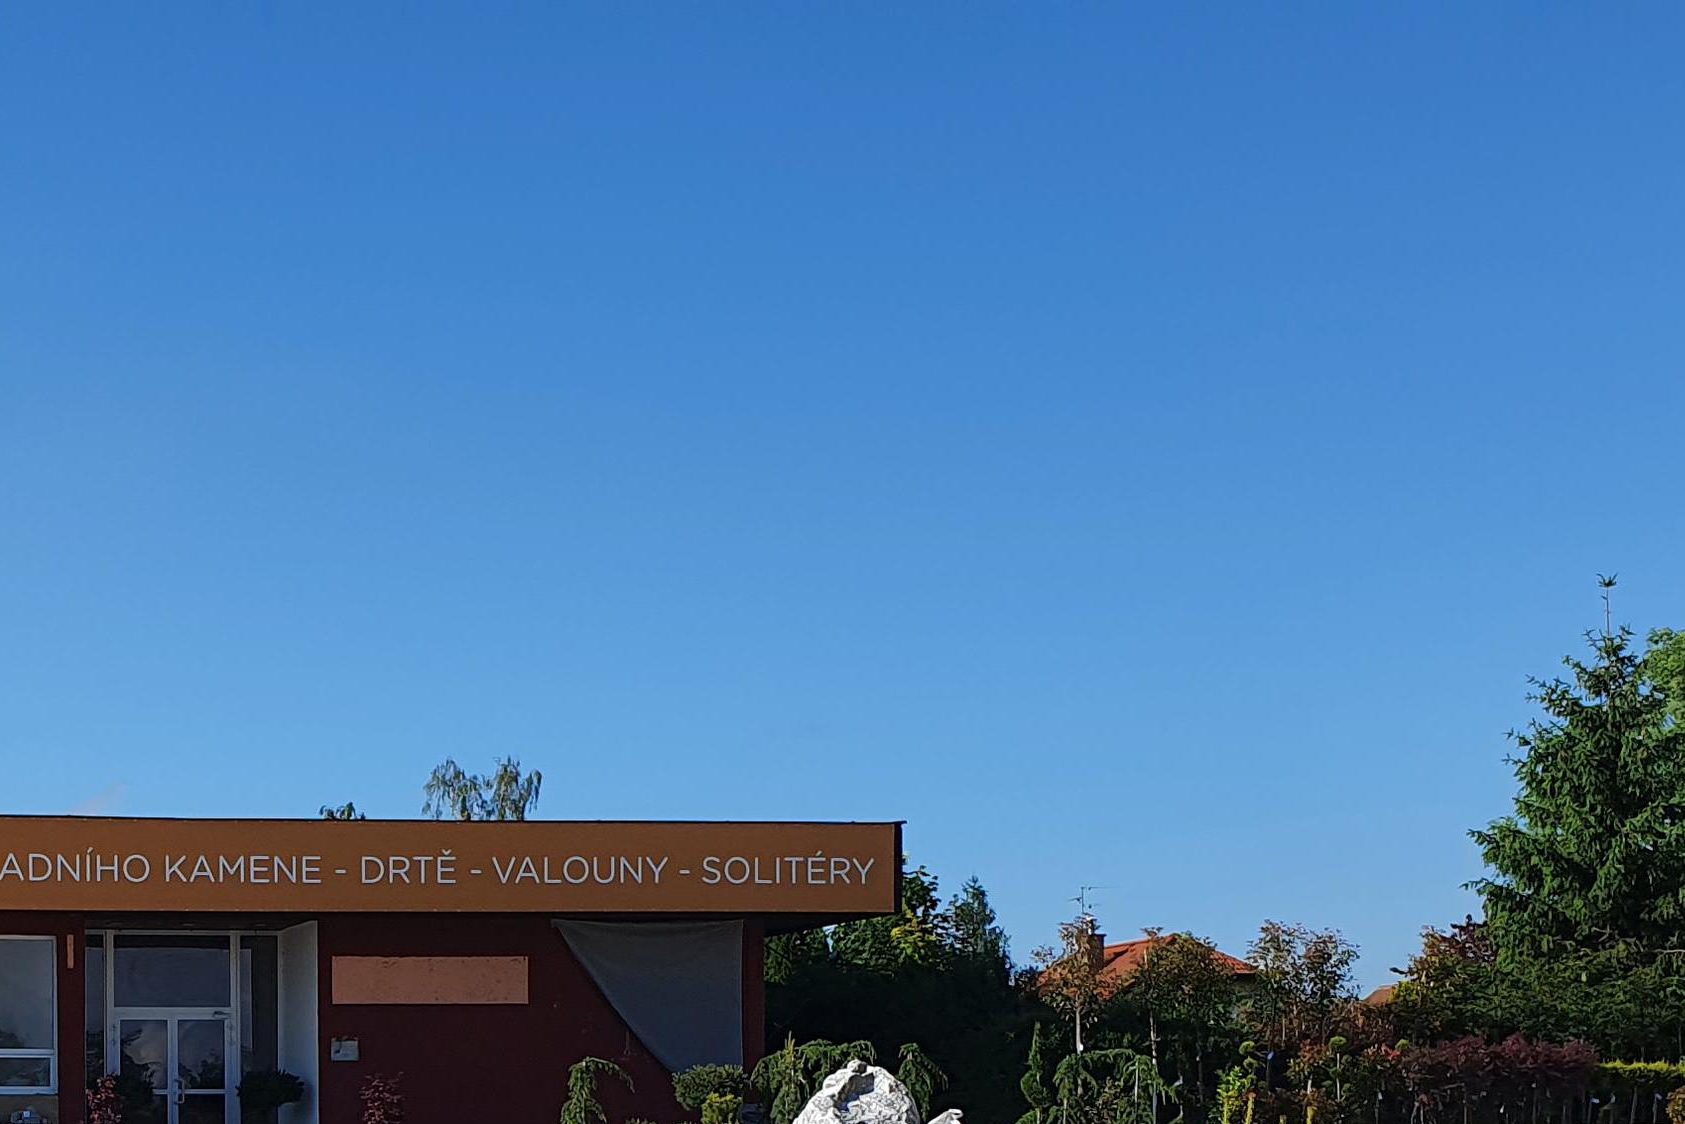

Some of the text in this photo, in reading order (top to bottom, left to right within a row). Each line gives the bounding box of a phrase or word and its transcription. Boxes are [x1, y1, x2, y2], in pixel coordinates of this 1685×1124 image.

[165, 855, 322, 884] KAMENE
[361, 848, 457, 884] DRTĚ
[492, 855, 669, 885] VALOUNY
[701, 850, 875, 885] SOLITÉRY
